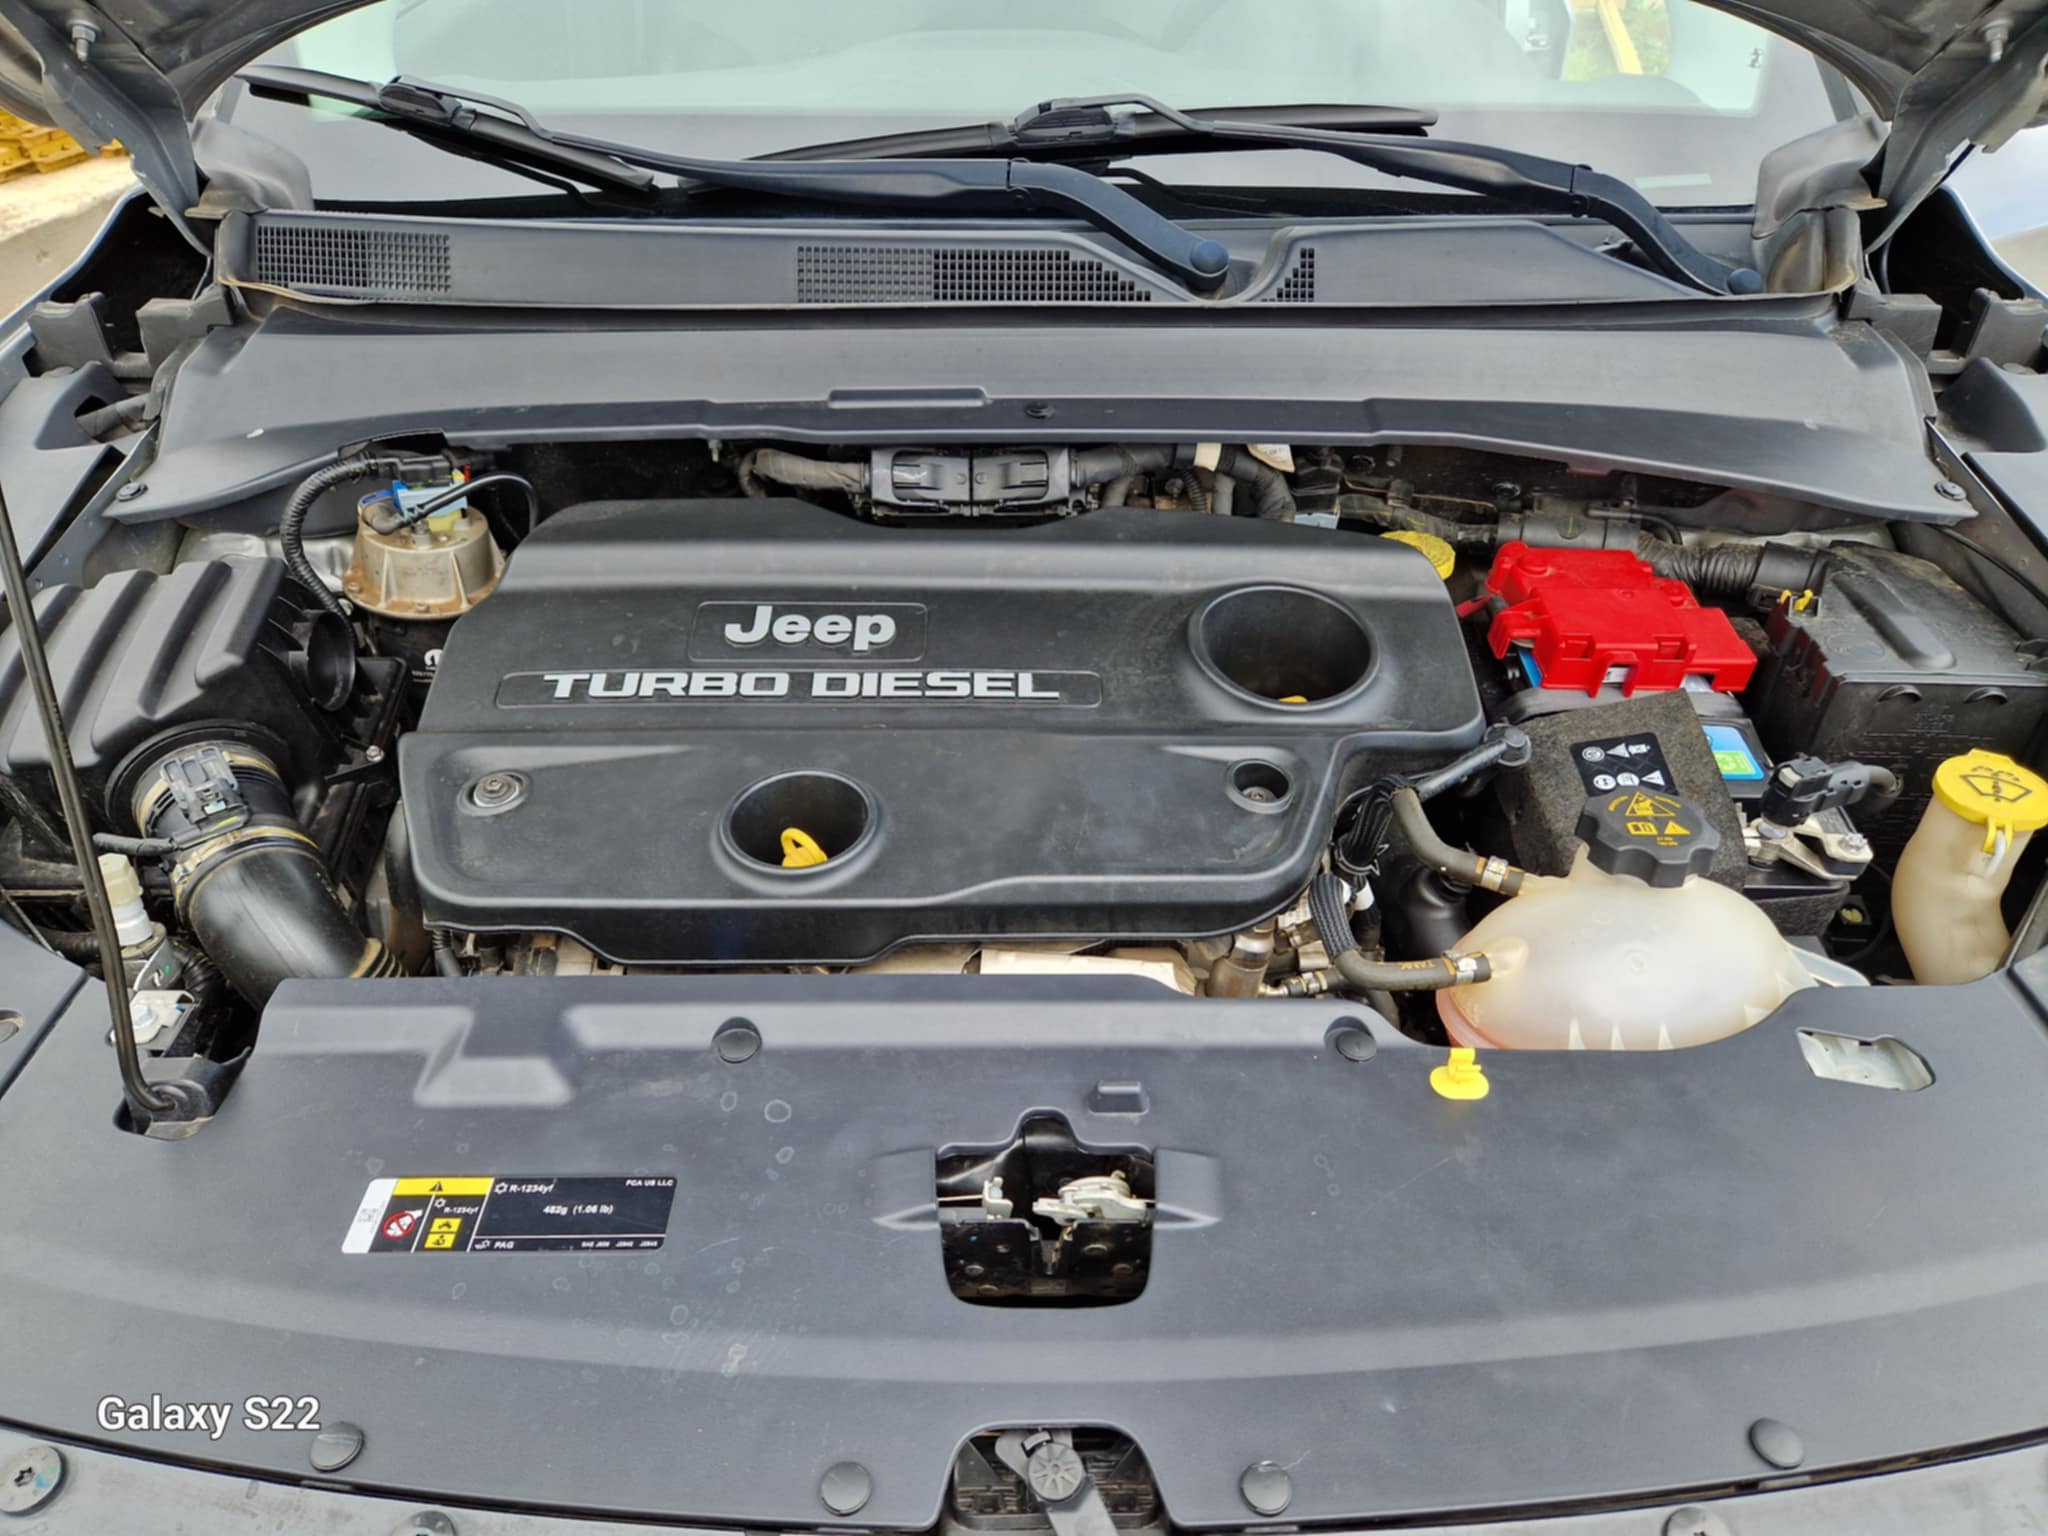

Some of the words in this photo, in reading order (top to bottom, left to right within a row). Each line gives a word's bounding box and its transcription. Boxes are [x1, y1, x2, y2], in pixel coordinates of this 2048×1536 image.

[725, 606, 896, 650] Jeep
[543, 673, 789, 698] TURBO
[811, 673, 1060, 698] DIESEL
[509, 1183, 554, 1194] R-1234yf
[625, 1179, 642, 1187] FCA
[657, 1179, 674, 1187] LLC
[494, 1241, 514, 1249] PAG
